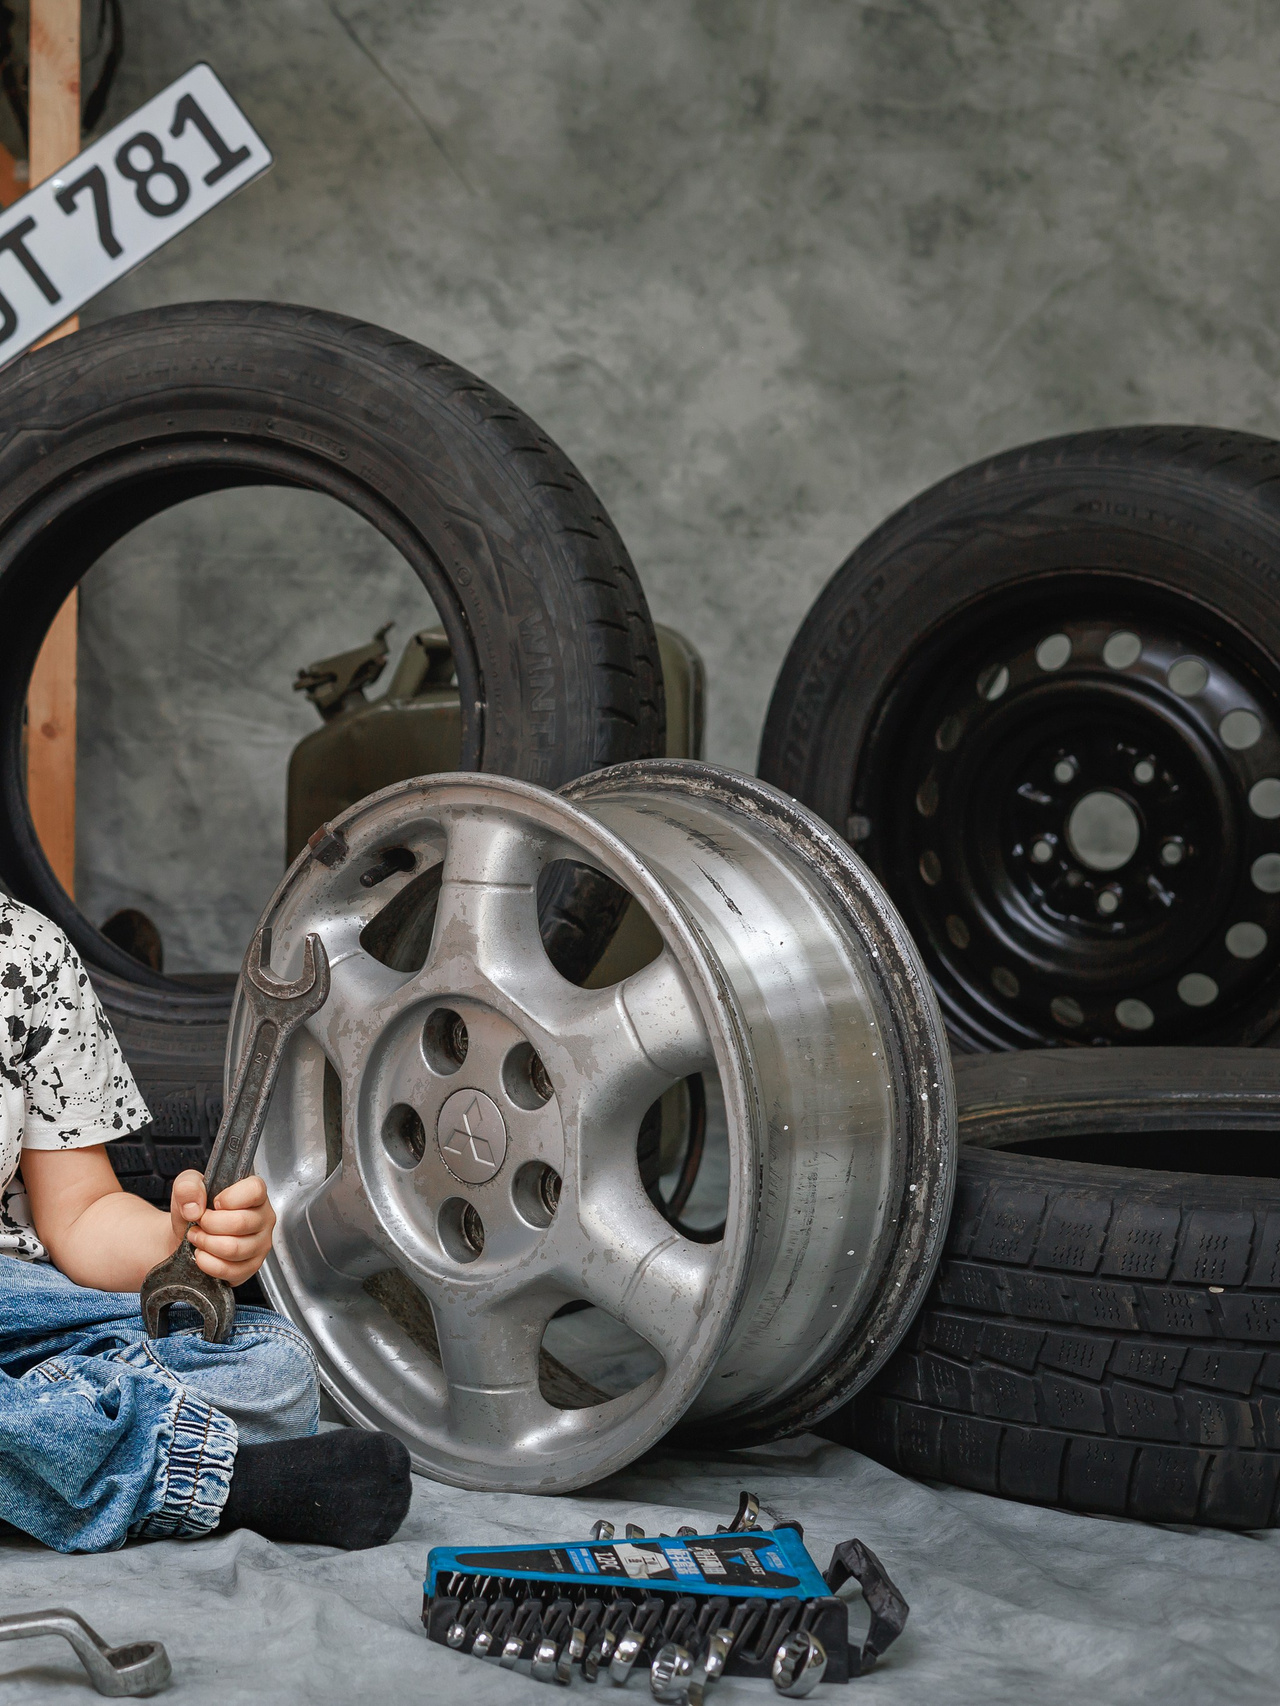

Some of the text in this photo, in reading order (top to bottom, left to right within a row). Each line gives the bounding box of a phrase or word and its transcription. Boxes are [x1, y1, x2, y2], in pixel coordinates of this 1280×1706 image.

[53, 93, 252, 260] 781
[518, 606, 557, 784] WINTE
[594, 1551, 621, 1571] 12PC
